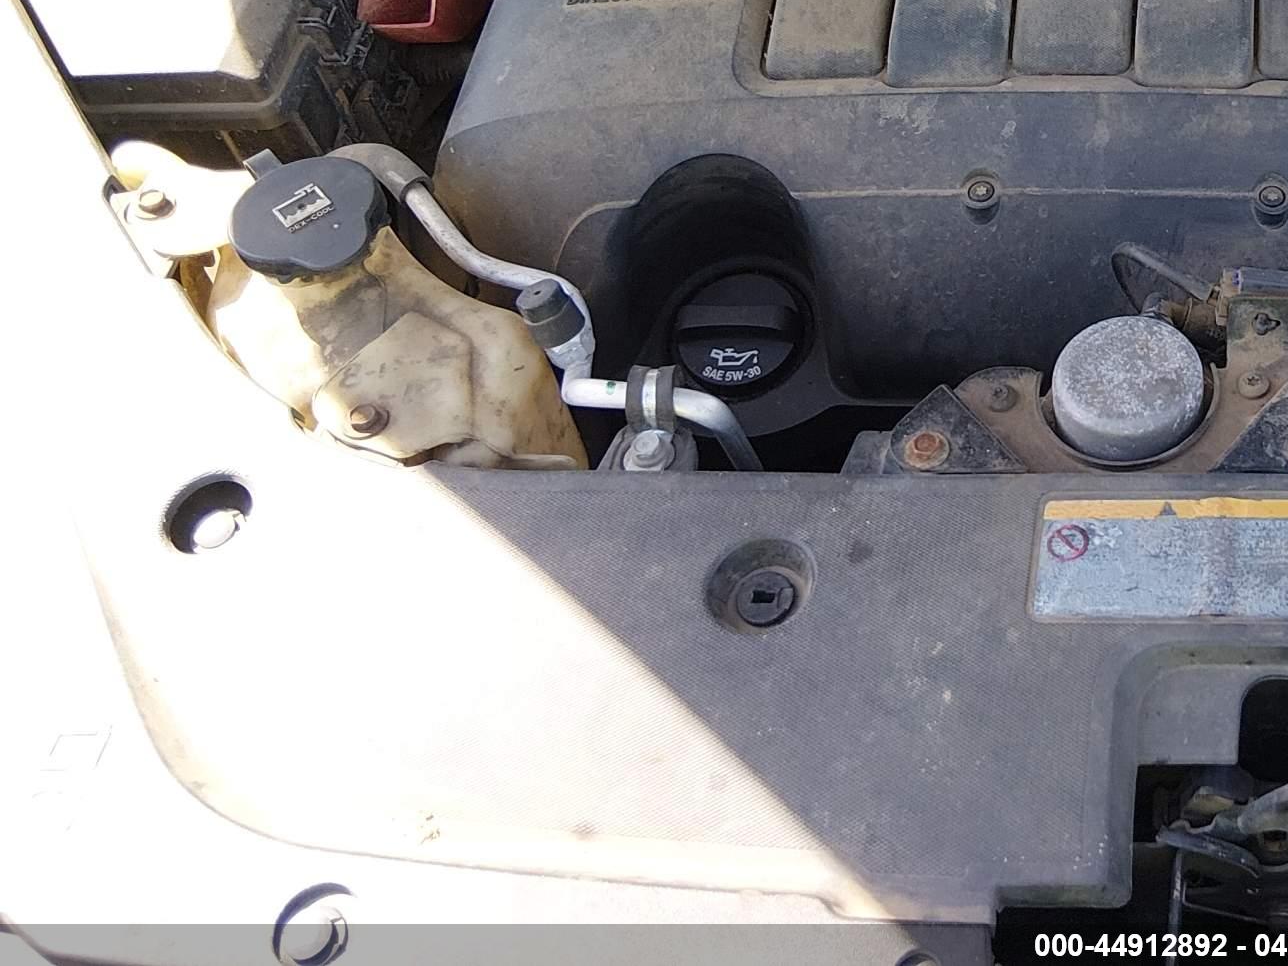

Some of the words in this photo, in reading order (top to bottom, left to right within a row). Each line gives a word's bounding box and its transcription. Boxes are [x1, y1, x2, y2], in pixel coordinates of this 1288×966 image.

[287, 205, 336, 235] DEX-COOL
[702, 365, 724, 381] SAE
[725, 365, 762, 381] 5W-30
